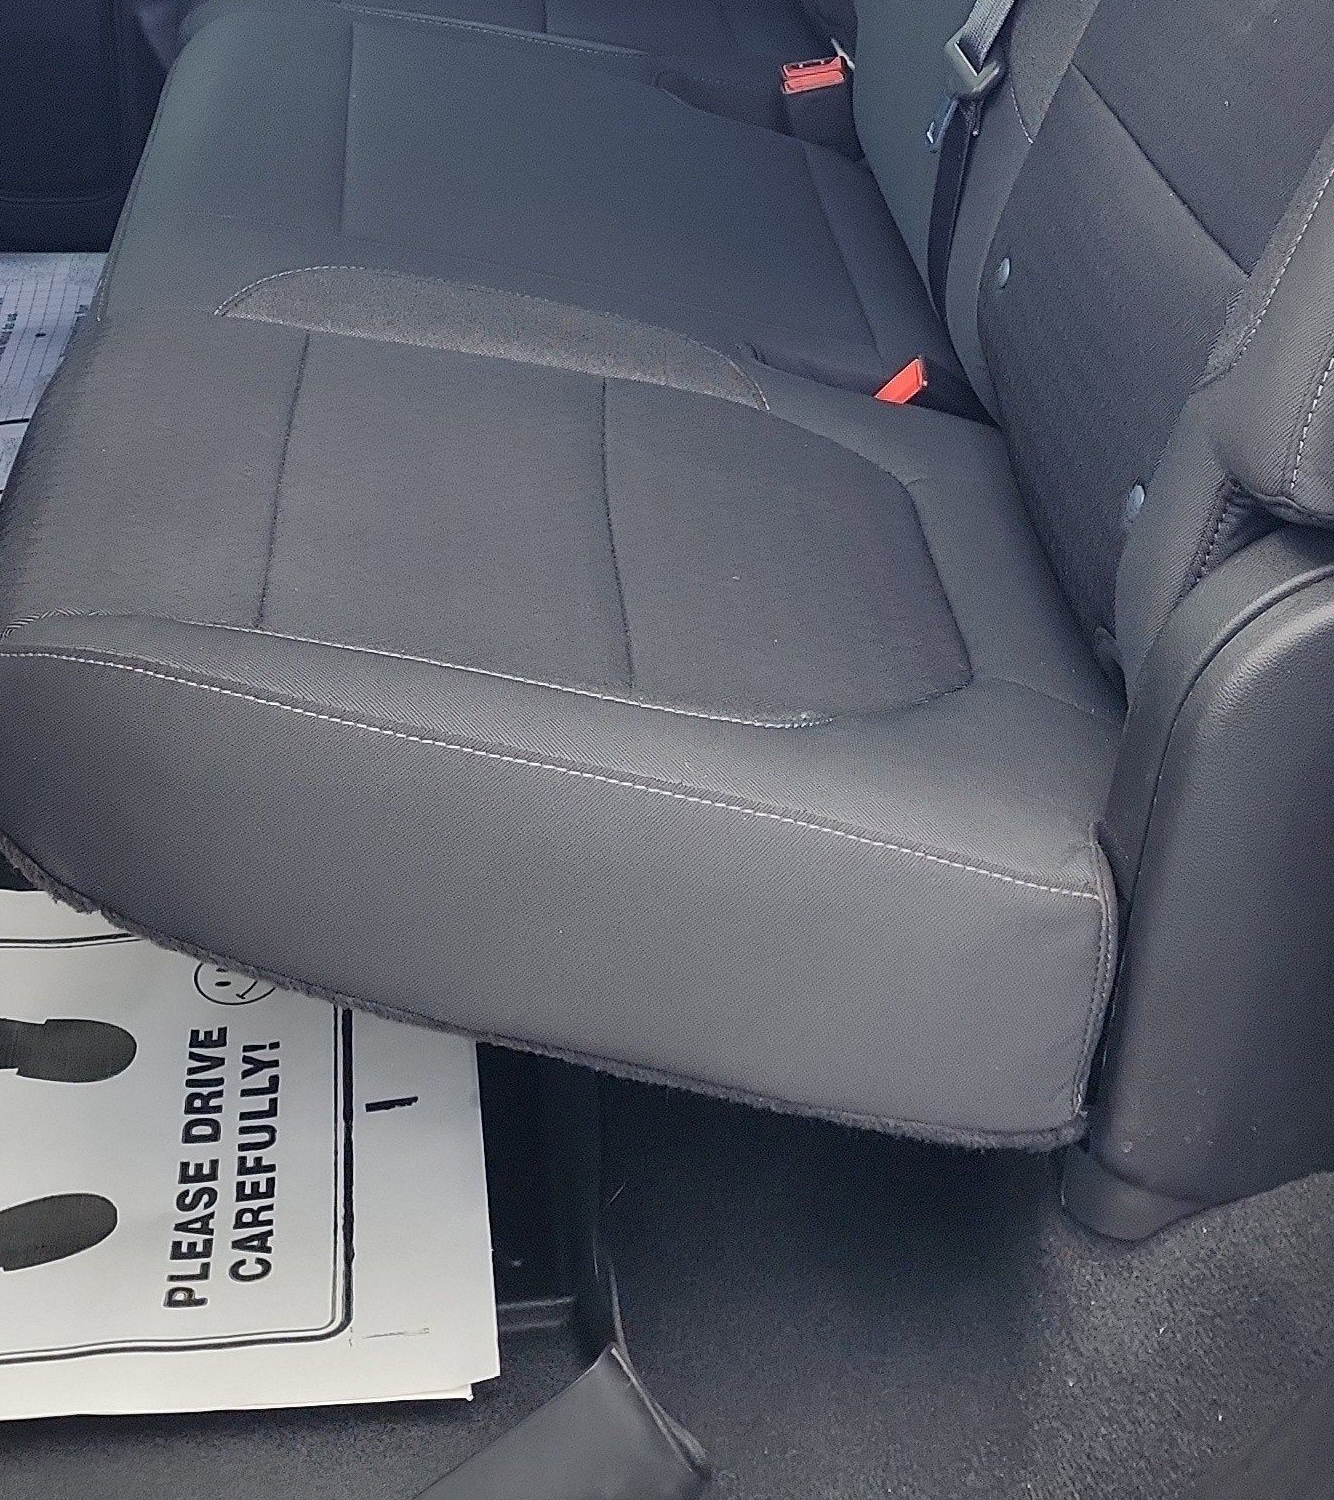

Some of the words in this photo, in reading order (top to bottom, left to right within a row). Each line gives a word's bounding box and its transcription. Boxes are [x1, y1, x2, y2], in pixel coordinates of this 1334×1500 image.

[181, 1026, 228, 1144] DRIVE
[163, 1158, 219, 1309] PLEASE
[229, 1041, 280, 1282] CAREFULLY!
